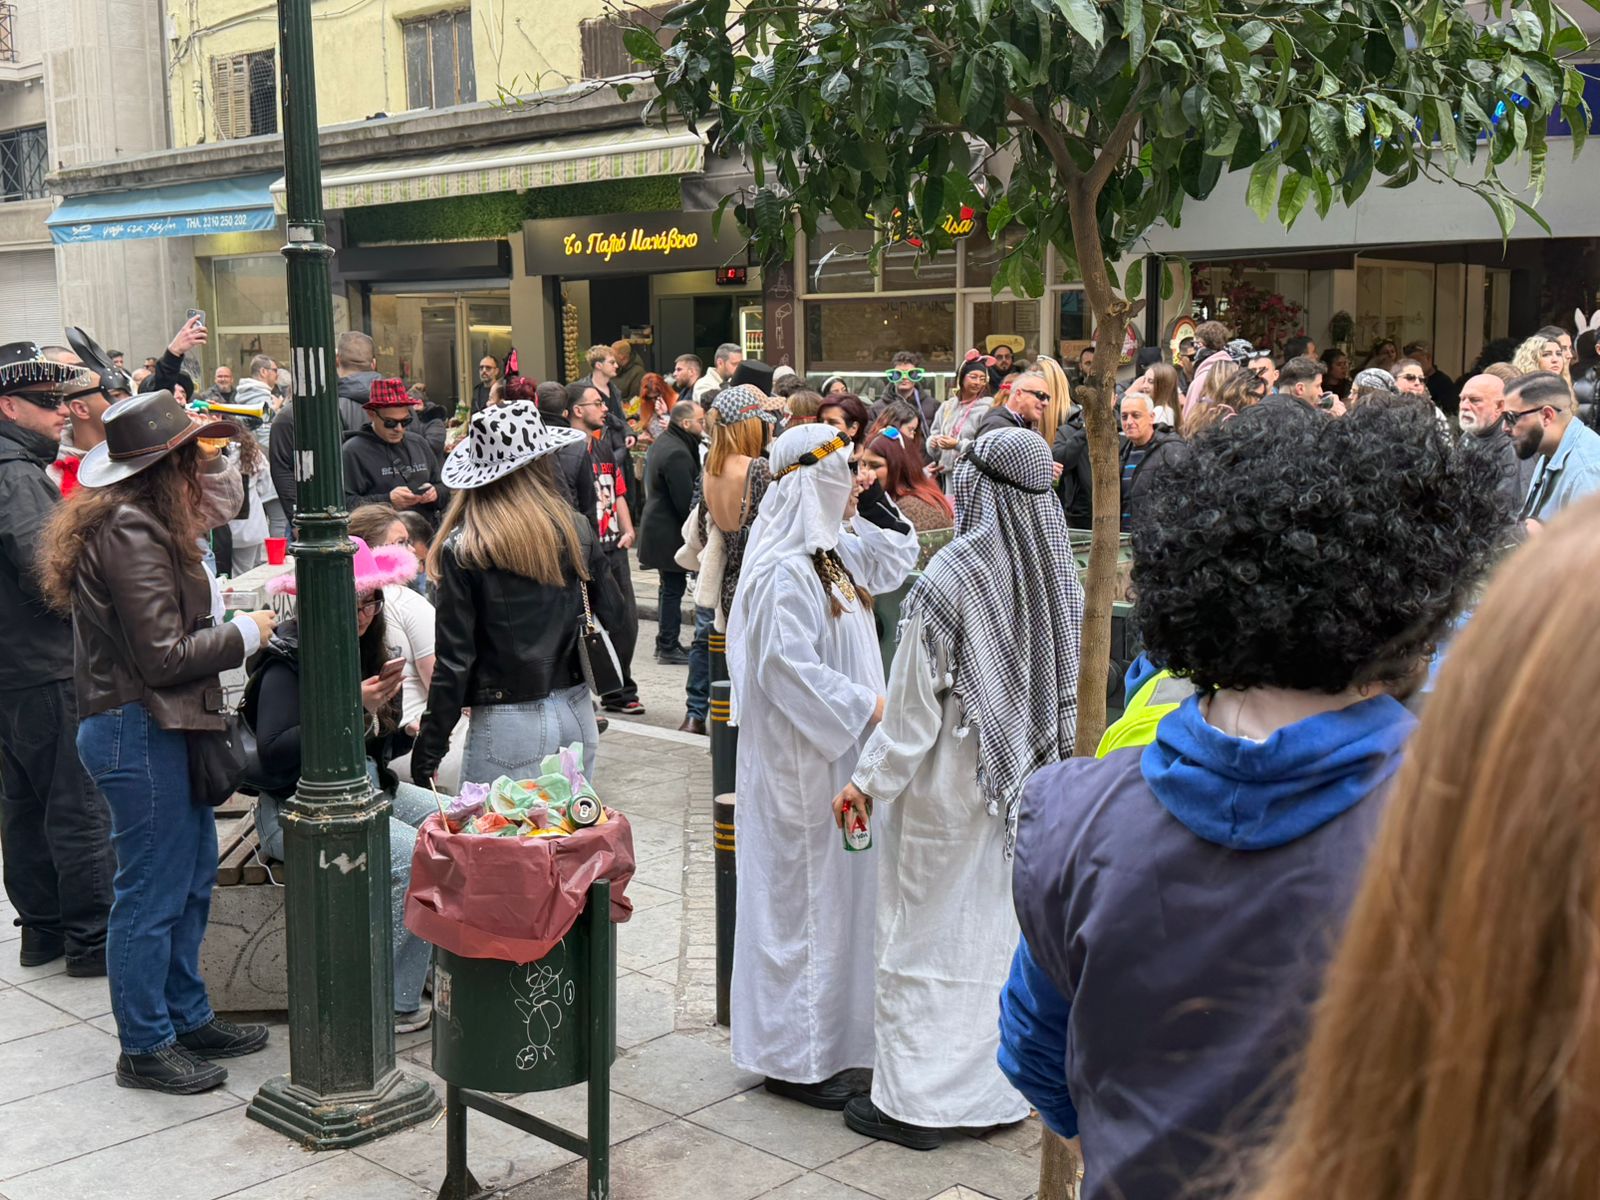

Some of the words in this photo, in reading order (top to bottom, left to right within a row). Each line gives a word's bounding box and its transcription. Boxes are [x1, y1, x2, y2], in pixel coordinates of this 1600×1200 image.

[220, 214, 233, 227] 250
[234, 214, 247, 225] 202
[563, 232, 583, 256] Το
[628, 226, 699, 255] Μανάβικο
